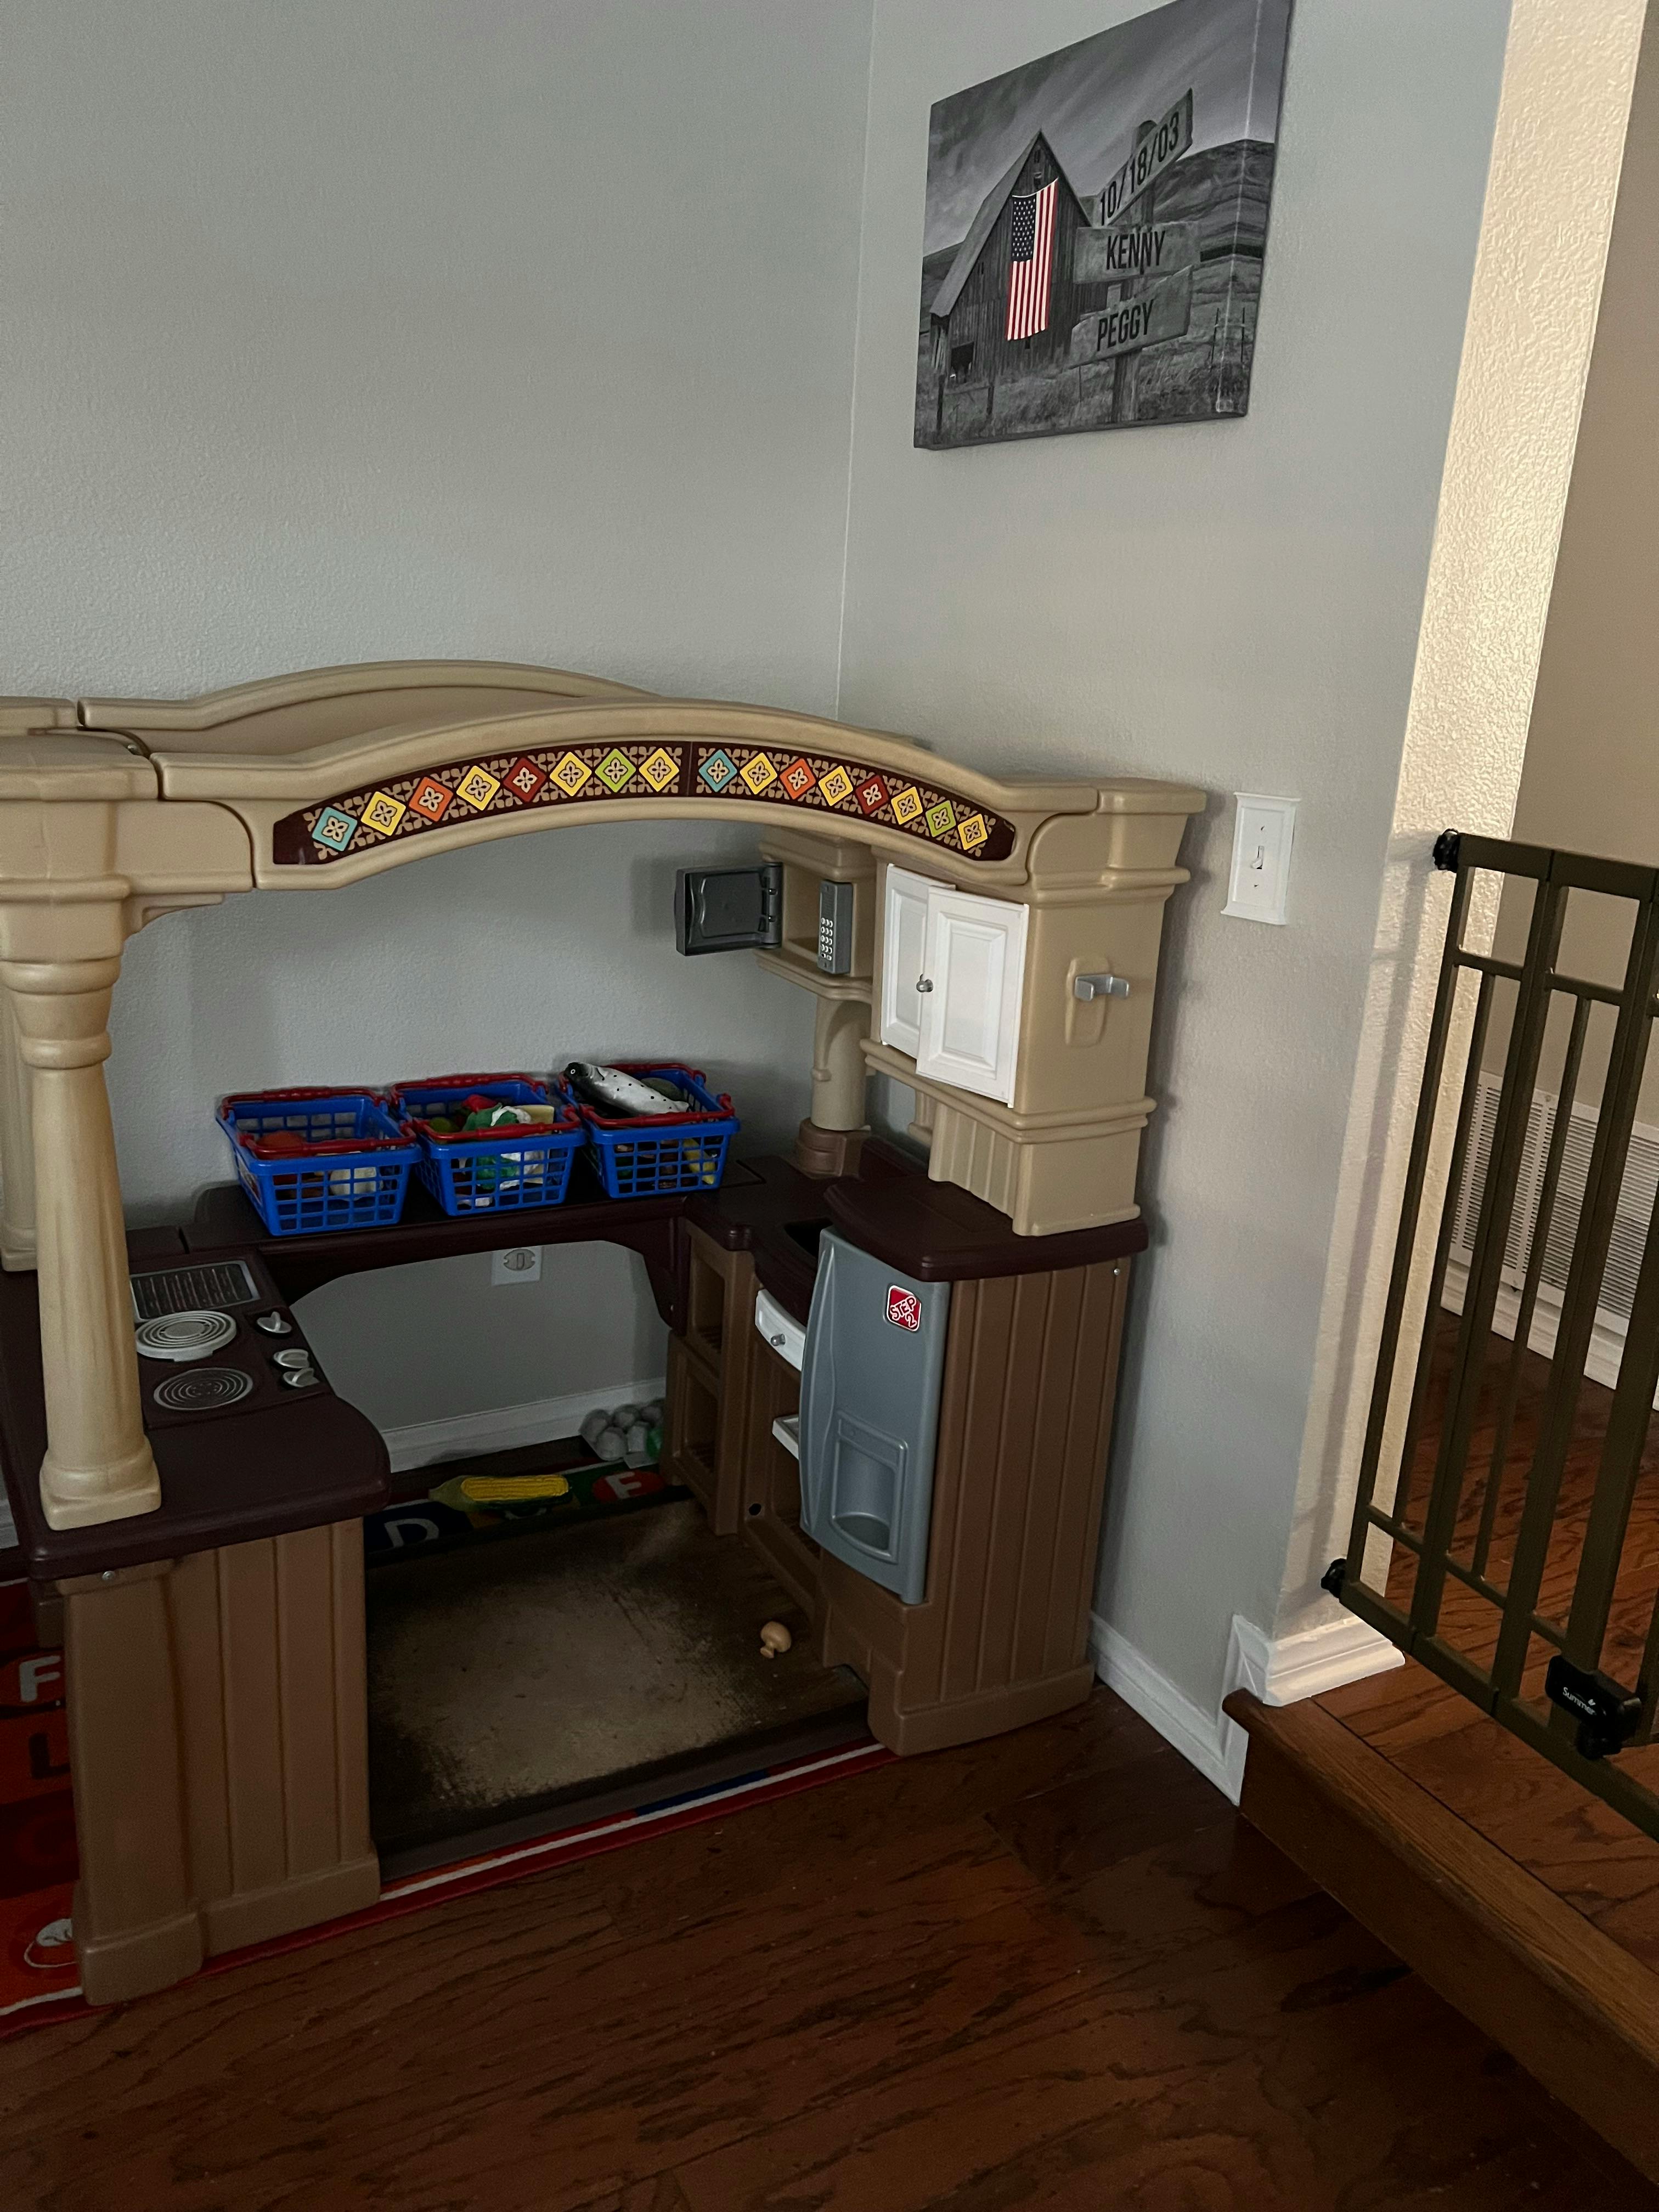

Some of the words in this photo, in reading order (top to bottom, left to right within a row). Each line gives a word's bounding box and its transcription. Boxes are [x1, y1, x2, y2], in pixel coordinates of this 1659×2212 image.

[1099, 111, 1180, 225] 10/18/03
[1106, 230, 1166, 271] KENNY
[1097, 298, 1154, 352] PEGGY
[889, 1296, 916, 1321] STEP
[905, 1313, 917, 1328] 2
[383, 1517, 439, 1548] D
[19, 1655, 61, 1703] F
[1562, 1686, 1597, 1716] Summer
